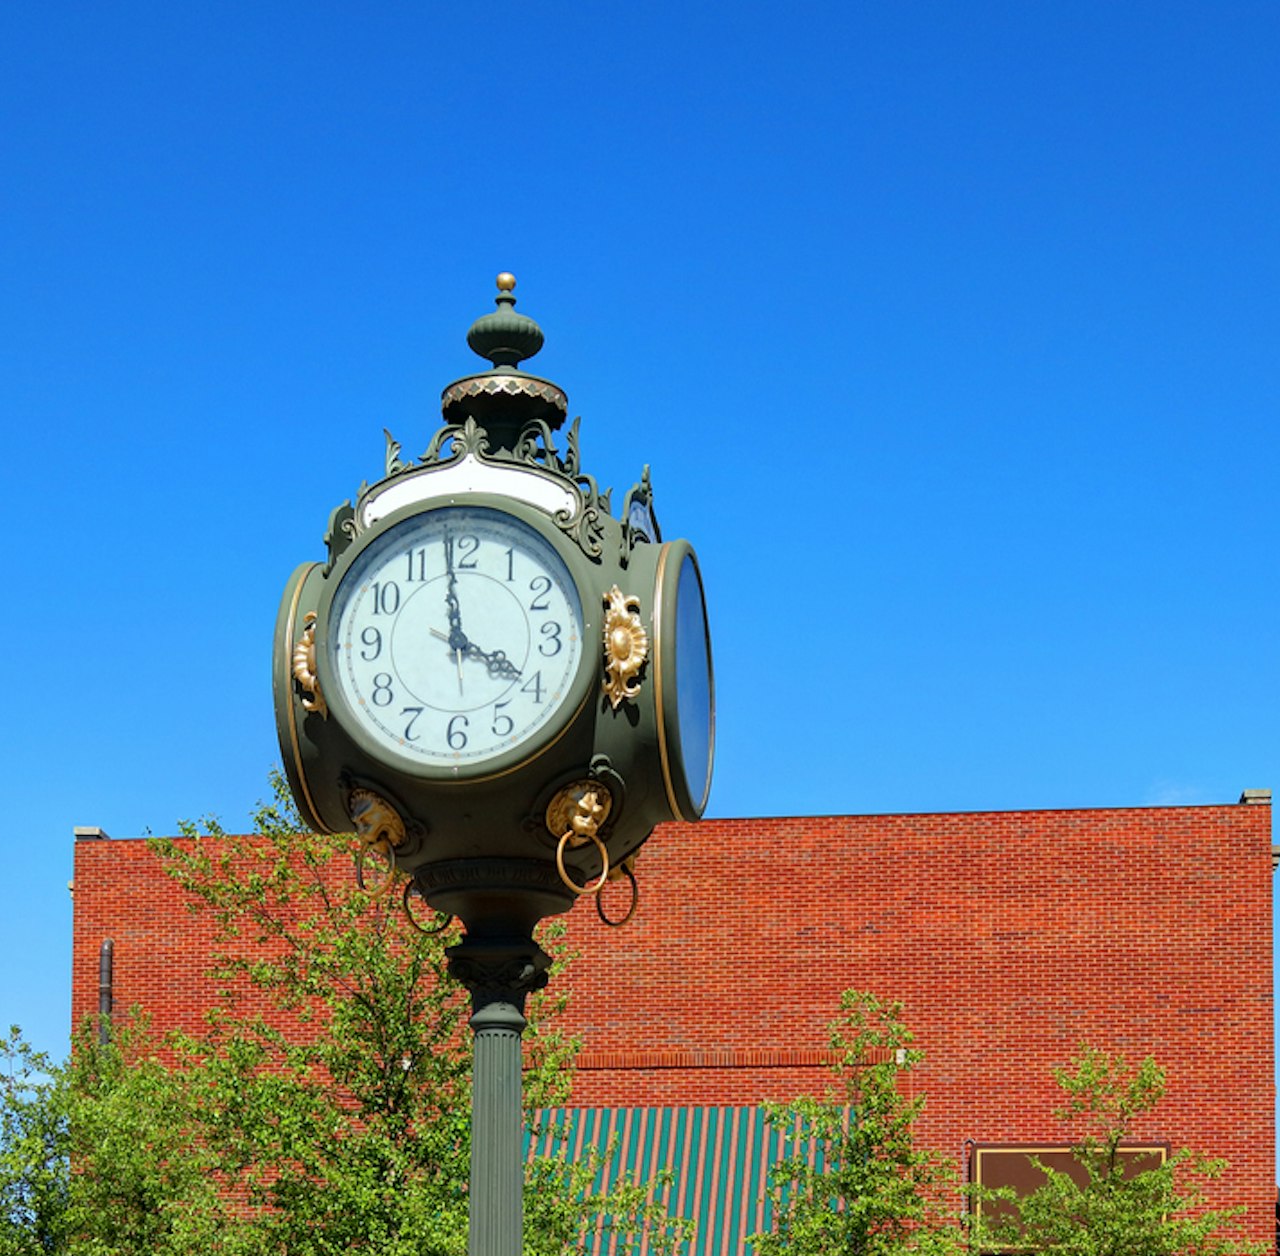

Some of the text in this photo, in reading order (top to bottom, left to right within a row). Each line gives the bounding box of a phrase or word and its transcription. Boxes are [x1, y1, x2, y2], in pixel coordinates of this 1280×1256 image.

[405, 549, 427, 582] 11
[447, 535, 480, 570] 12
[505, 547, 515, 582] 1
[371, 581, 400, 615] 10
[530, 575, 552, 611] 2
[361, 626, 382, 661] 9
[539, 621, 562, 657] 3
[372, 673, 393, 707] 8
[521, 670, 547, 704] 4
[400, 707, 424, 741] 7
[446, 715, 469, 750] 6
[491, 700, 515, 736] 5
